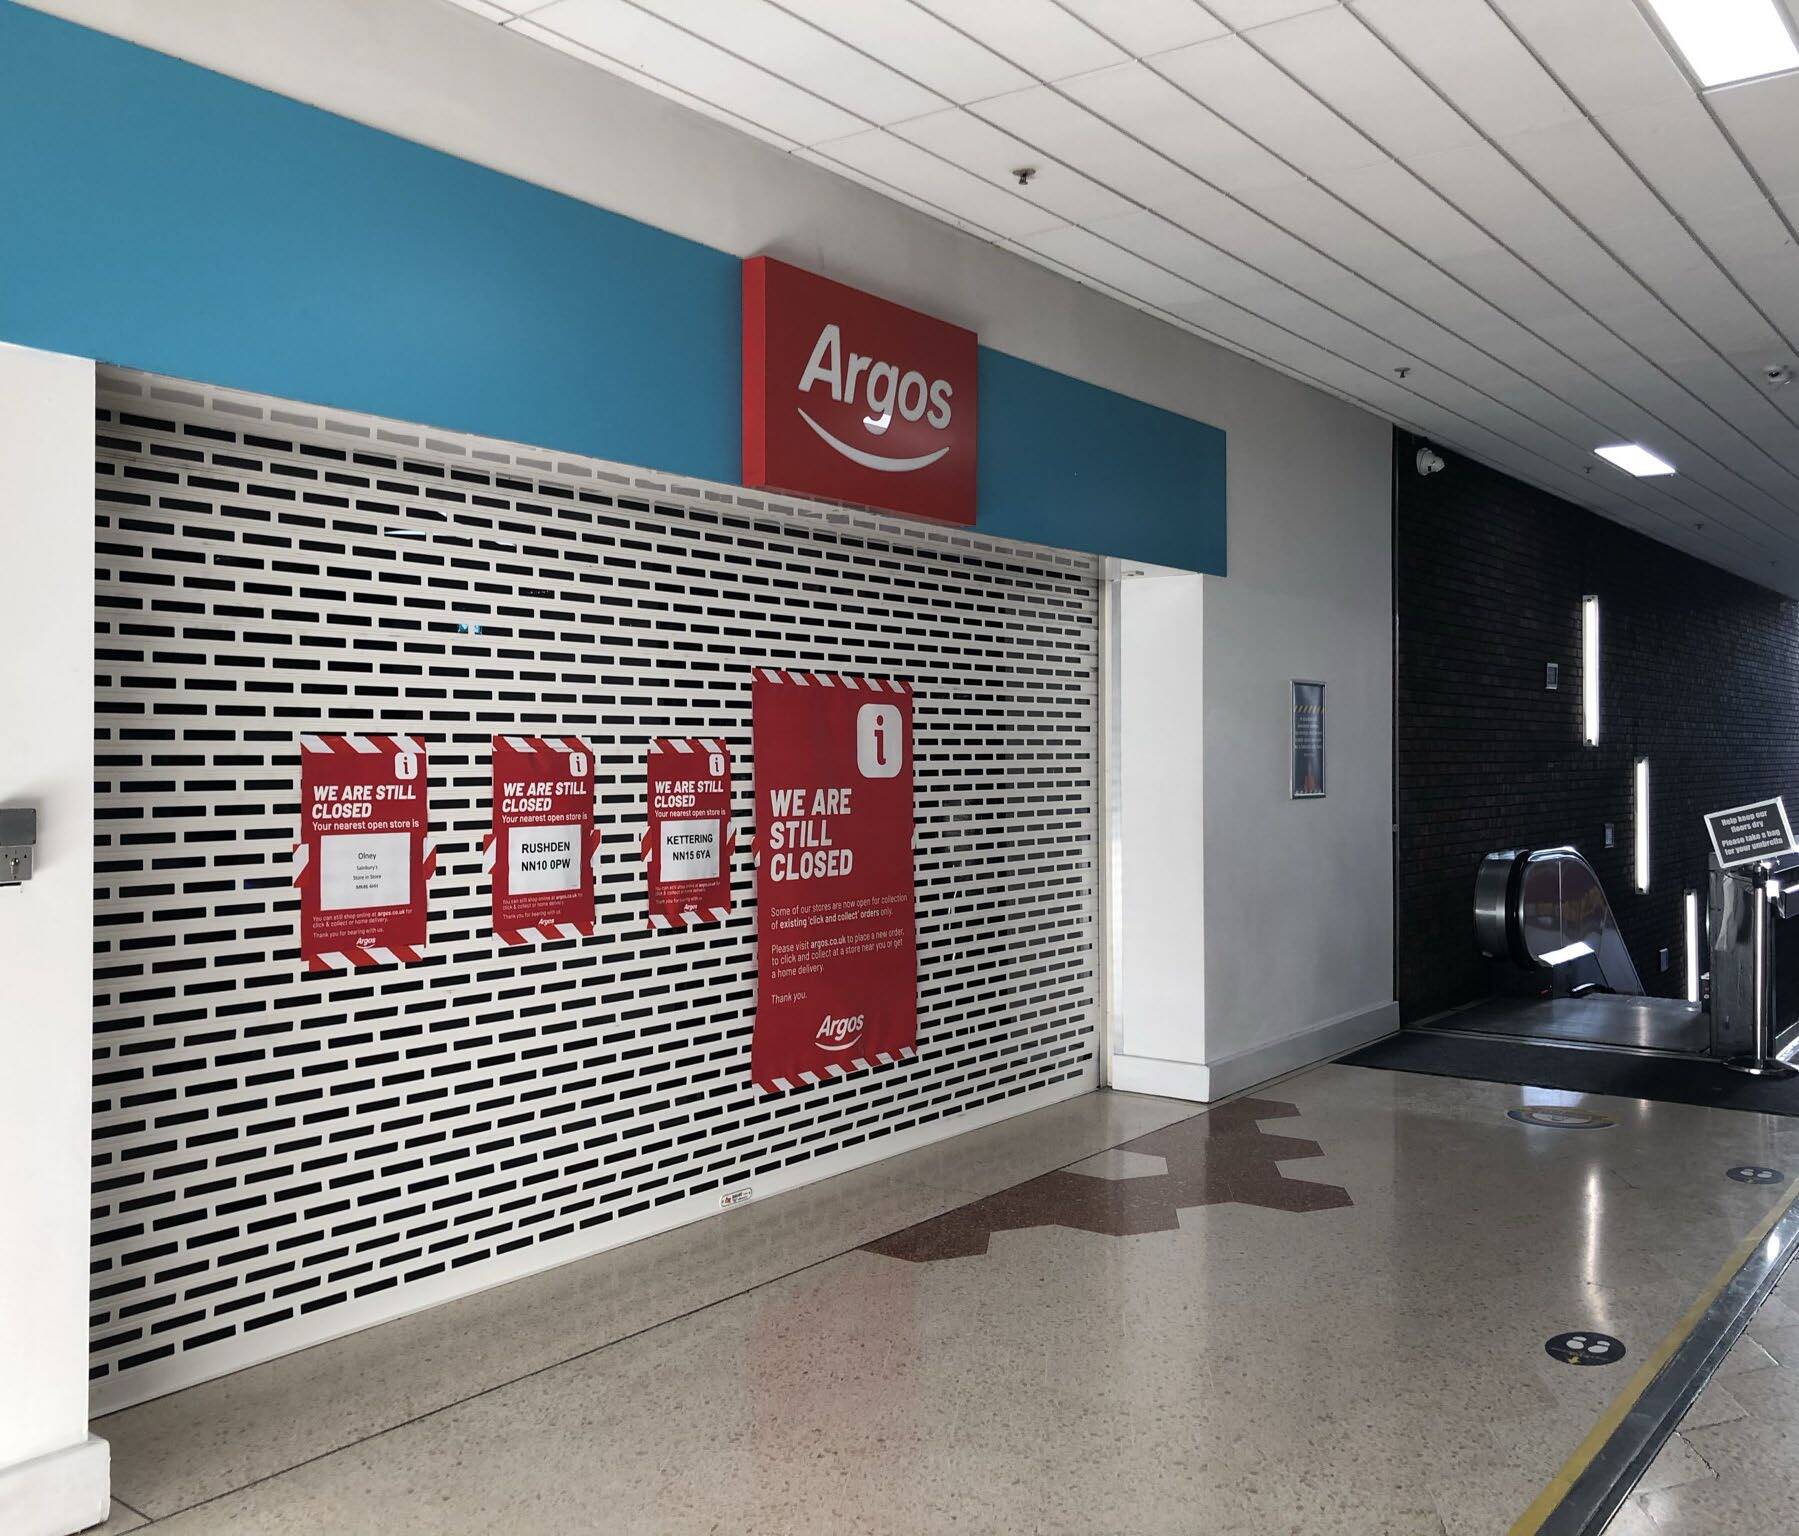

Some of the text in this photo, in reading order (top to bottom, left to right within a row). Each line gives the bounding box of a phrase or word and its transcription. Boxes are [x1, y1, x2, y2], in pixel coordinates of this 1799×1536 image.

[798, 324, 953, 436] Argos
[313, 784, 417, 801] WE ARE STILL
[503, 781, 587, 797] WE ARE STILL
[654, 780, 724, 794] WE ARE STILL
[502, 797, 552, 813] CLOSED
[654, 794, 696, 808] CLOSED
[769, 788, 852, 817] WE ARE
[312, 803, 372, 819] CLOSED
[502, 812, 588, 824] Your nearest open store is
[655, 809, 669, 818] Your
[692, 810, 706, 818] open
[1721, 810, 1768, 827] Help keep our
[312, 818, 420, 831] Your nearest open store is
[1730, 820, 1764, 833] floors dry
[666, 834, 713, 845] KETTERING
[769, 819, 832, 850] STILL
[1721, 837, 1745, 848] Please
[1745, 833, 1761, 842] take
[1766, 829, 1781, 837] bag
[521, 841, 570, 854] RUSHDEN
[1724, 837, 1784, 856] for your umbrella
[357, 852, 377, 861] Olney
[672, 850, 711, 861] NN15 6YA
[521, 860, 547, 872] NN10
[770, 849, 853, 882] CLOSED
[770, 907, 791, 917] Some
[792, 905, 799, 915] of
[800, 905, 811, 914] our
[812, 903, 832, 912] stores
[856, 899, 871, 908] open
[871, 896, 880, 905] for
[881, 894, 908, 904] collection
[538, 918, 555, 926] Argos
[771, 920, 778, 930] of
[779, 918, 807, 928] existing
[825, 913, 837, 923] and
[860, 909, 880, 918] orders
[356, 937, 376, 946] Argos
[771, 944, 795, 954] Please
[795, 940, 809, 950] visit
[810, 935, 846, 949] argos.co.uk
[847, 935, 854, 943] to
[854, 933, 870, 944] place
[871, 932, 875, 940] a
[876, 931, 888, 939] new
[771, 957, 779, 966] to
[780, 954, 796, 964] click
[797, 951, 810, 962] and
[811, 949, 831, 960] collect
[832, 947, 839, 956] at
[845, 946, 861, 955] store
[861, 943, 875, 952] near
[875, 941, 886, 952] you
[886, 940, 893, 948] or
[893, 938, 903, 949] get
[771, 970, 776, 979] a
[777, 967, 796, 978] home
[771, 992, 807, 1005] Thank you.
[815, 1014, 865, 1041] Argos
